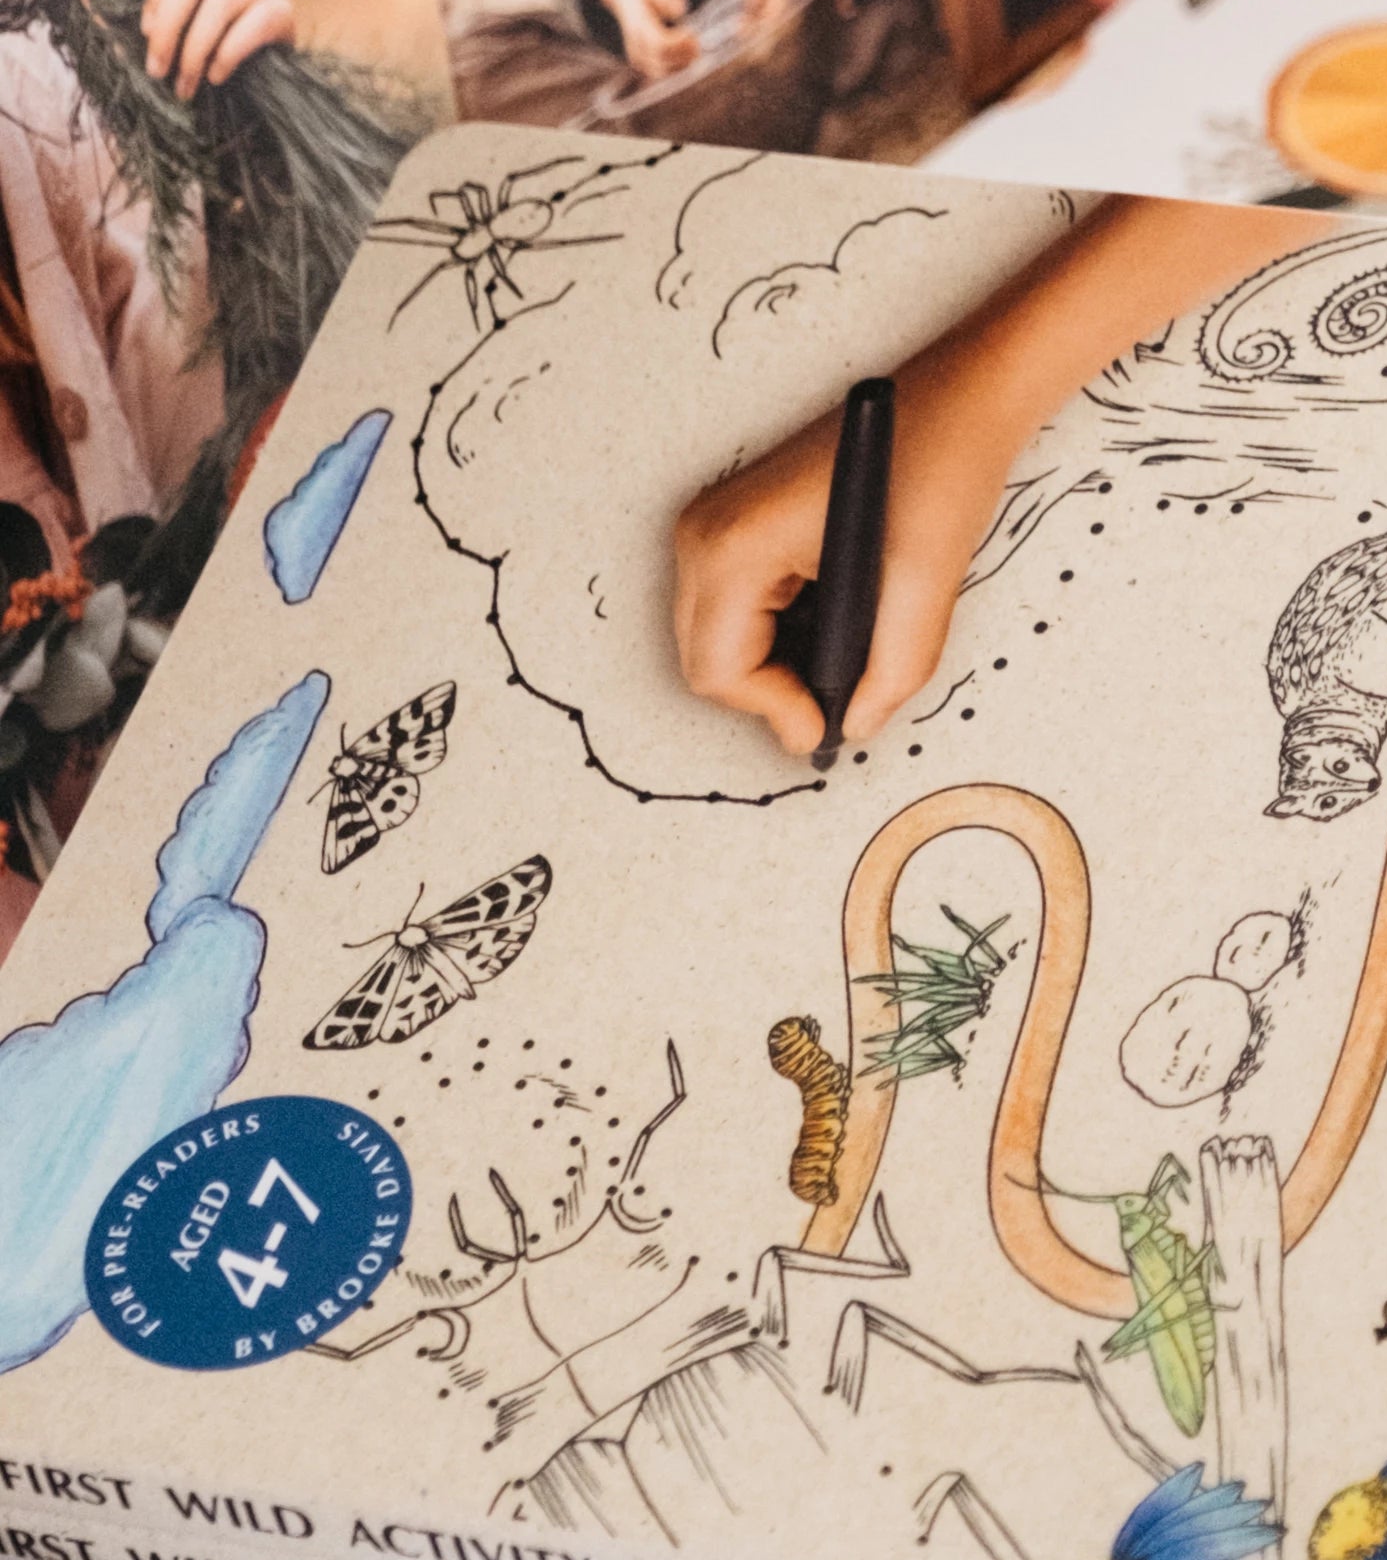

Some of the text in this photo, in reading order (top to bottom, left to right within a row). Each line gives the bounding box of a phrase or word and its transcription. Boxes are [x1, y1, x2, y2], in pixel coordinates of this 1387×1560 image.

[104, 1113, 262, 1339] FOR PRE-READERS
[169, 1180, 231, 1273] AGED
[216, 1156, 321, 1310] 4-7
[234, 1121, 401, 1360] BY BROOKE DAVIS
[0, 1460, 134, 1511] FIRST
[164, 1486, 316, 1540] WILD
